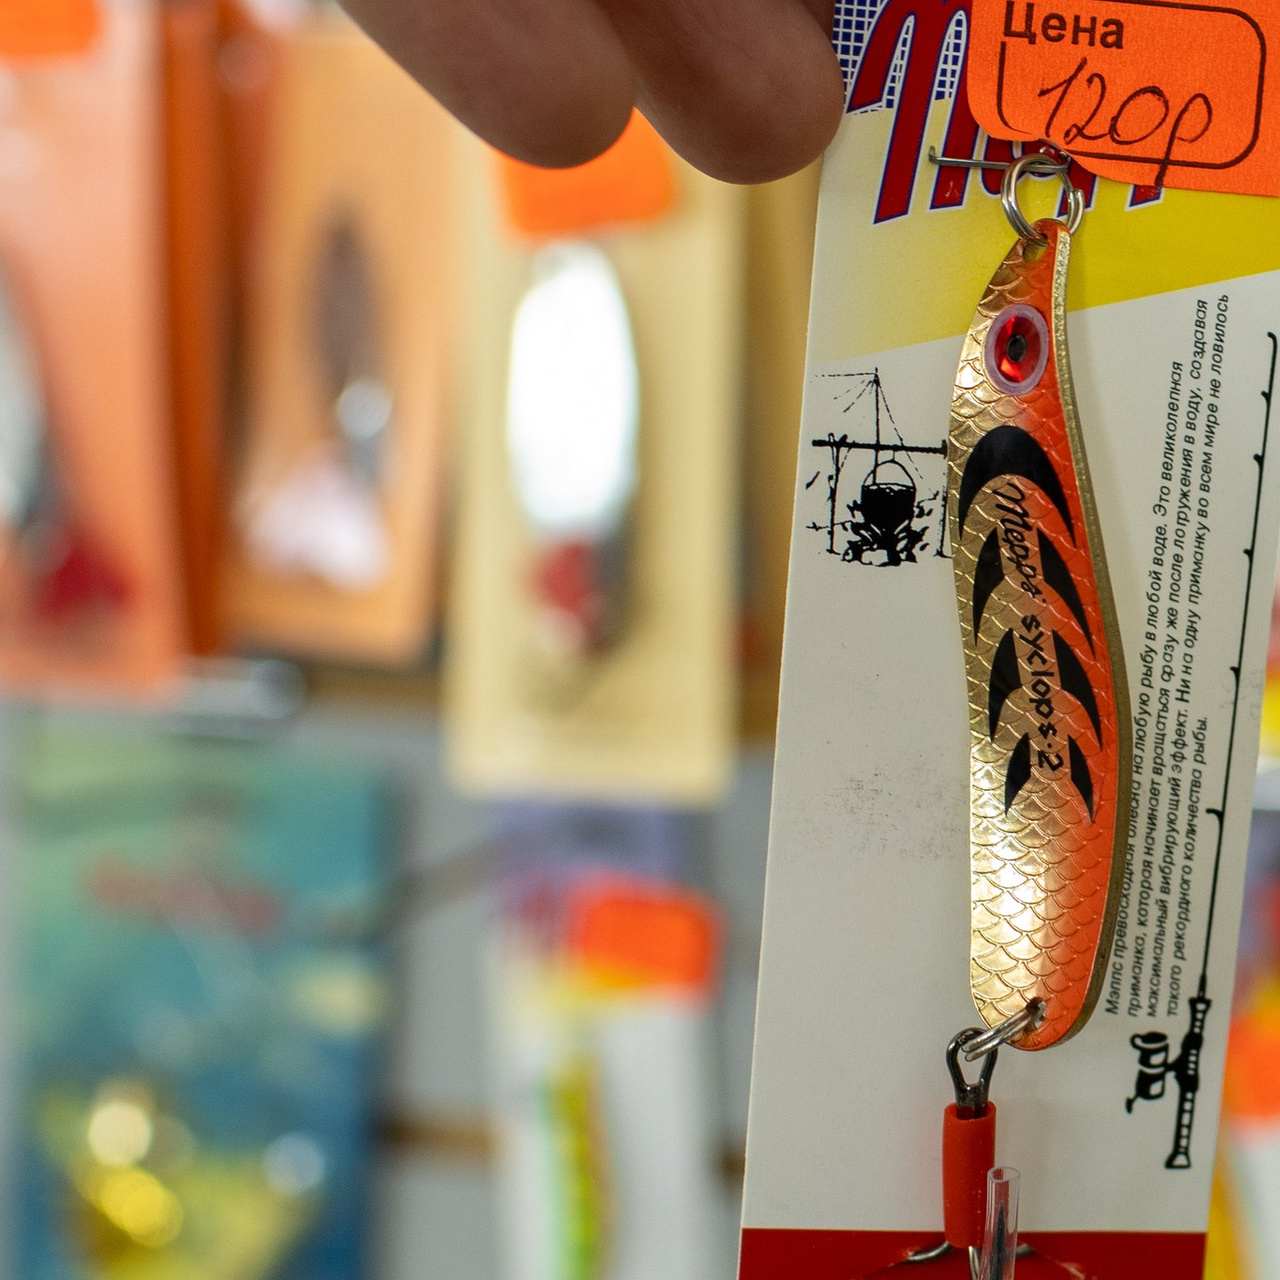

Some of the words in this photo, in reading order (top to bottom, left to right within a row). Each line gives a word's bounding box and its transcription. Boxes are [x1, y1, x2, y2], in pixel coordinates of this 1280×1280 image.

[1003, 0, 1124, 49] Цена
[1189, 299, 1209, 380] создавая
[1210, 294, 1229, 376] ловилось
[1185, 387, 1204, 432] воду,
[1209, 378, 1222, 399] не
[1160, 360, 1184, 482] великолепная
[1203, 402, 1221, 448] мире
[1198, 451, 1213, 494] всем
[1152, 485, 1171, 517] Это
[1196, 497, 1210, 519] во
[1152, 523, 1169, 568] воде.
[1187, 520, 1211, 605] приманку
[1145, 569, 1163, 630] любой
[1168, 552, 1184, 604] после
[1165, 606, 1179, 631] же
[1183, 608, 1202, 649] одну
[1139, 643, 1159, 690] рыбу
[1181, 652, 1194, 676] на
[1174, 678, 1192, 704] Ни
[1130, 692, 1153, 754] любую
[1151, 687, 1171, 777] вращаться
[1169, 709, 1189, 774] эффект.
[1191, 716, 1208, 766] рыбы.
[1132, 753, 1144, 776] на
[1143, 777, 1162, 857] начинает
[1158, 776, 1182, 896] вибрирующий
[1183, 768, 1203, 862] количества
[1136, 858, 1154, 928] которая
[1173, 864, 1193, 962] рекордного
[1127, 932, 1148, 1018] приманка,
[1146, 898, 1169, 1018] максимальный
[1106, 959, 1124, 1015] Мэппс
[1166, 964, 1182, 1017] такого
